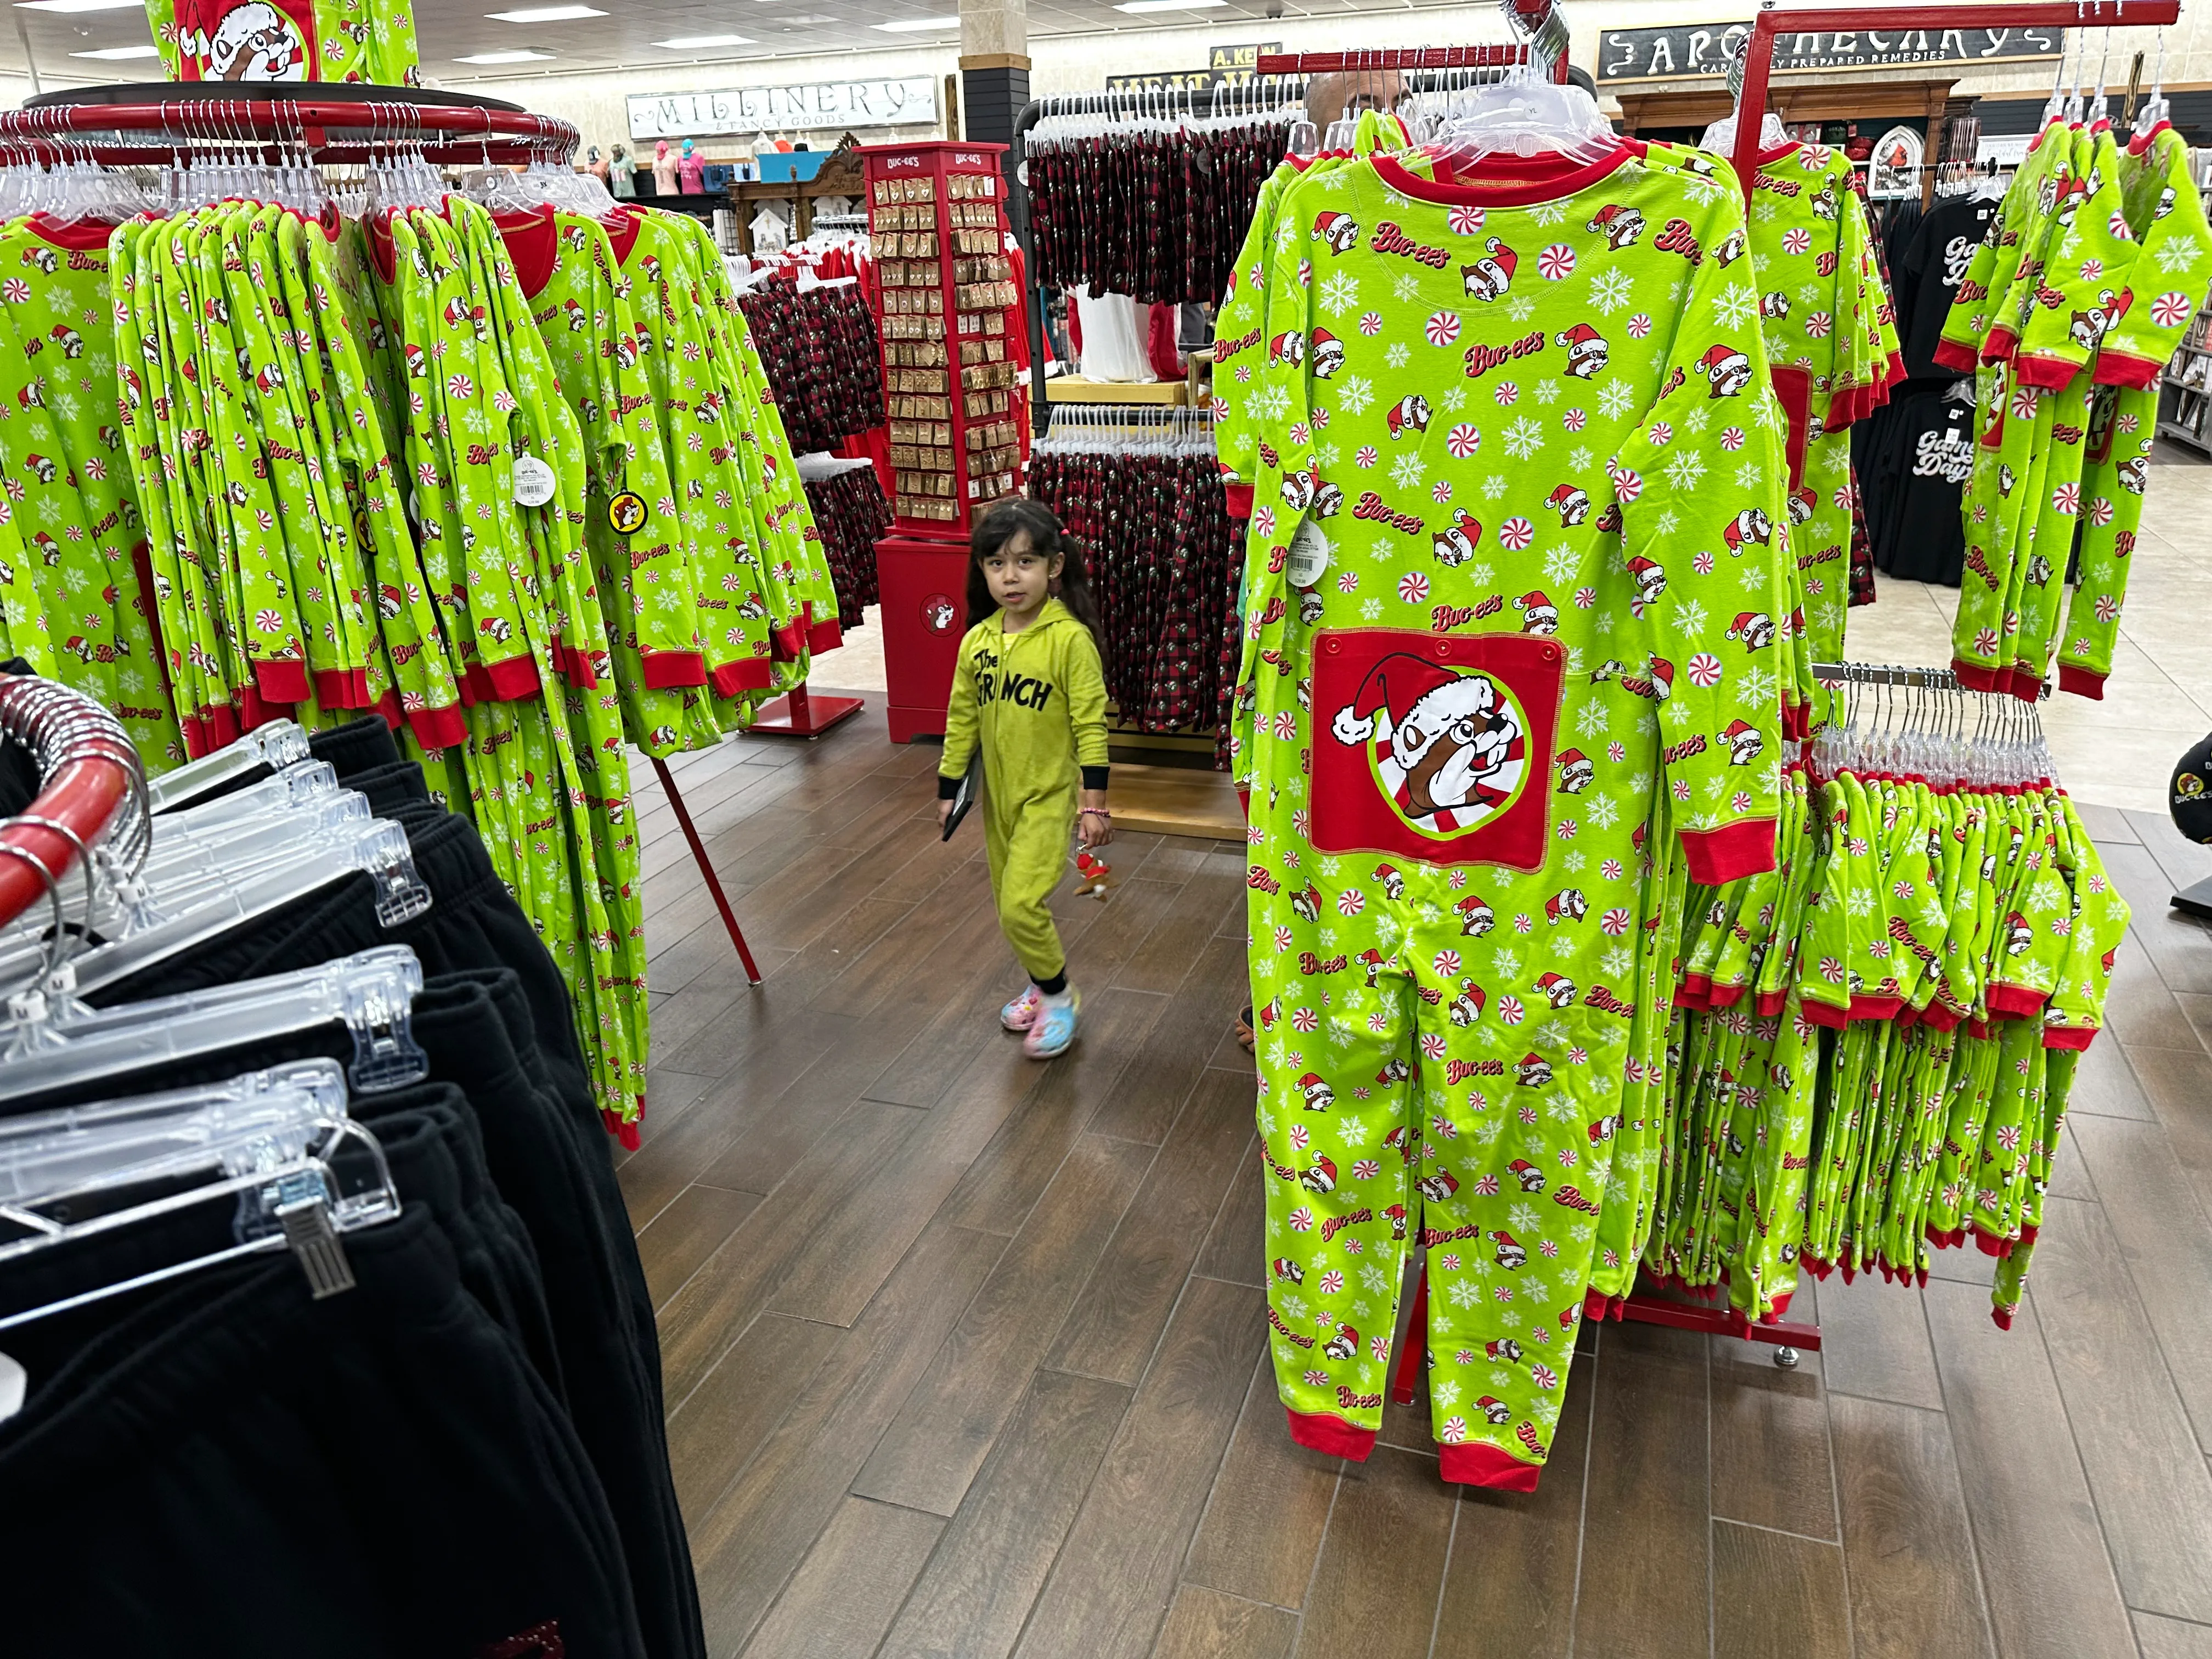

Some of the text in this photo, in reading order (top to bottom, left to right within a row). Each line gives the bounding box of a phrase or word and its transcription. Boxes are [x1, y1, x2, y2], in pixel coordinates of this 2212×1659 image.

[1212, 49, 1231, 66] A.
[1790, 55, 1865, 69] PREPARED
[1871, 50, 1946, 64] REMEDIES
[657, 83, 907, 133] MILLINERY
[715, 114, 846, 131] & FANCY GOODS
[1372, 221, 1451, 269] Buc-ee's
[1213, 328, 1262, 363] Buc-ee's
[1464, 331, 1545, 378] Buc-ee's
[1352, 492, 1425, 535] Buc-ee's
[1431, 594, 1503, 633] Buc-ee's
[974, 648, 998, 670] The
[1446, 1059, 1504, 1085] Buc-ee's
[1321, 1207, 1373, 1242] Buc-ee's
